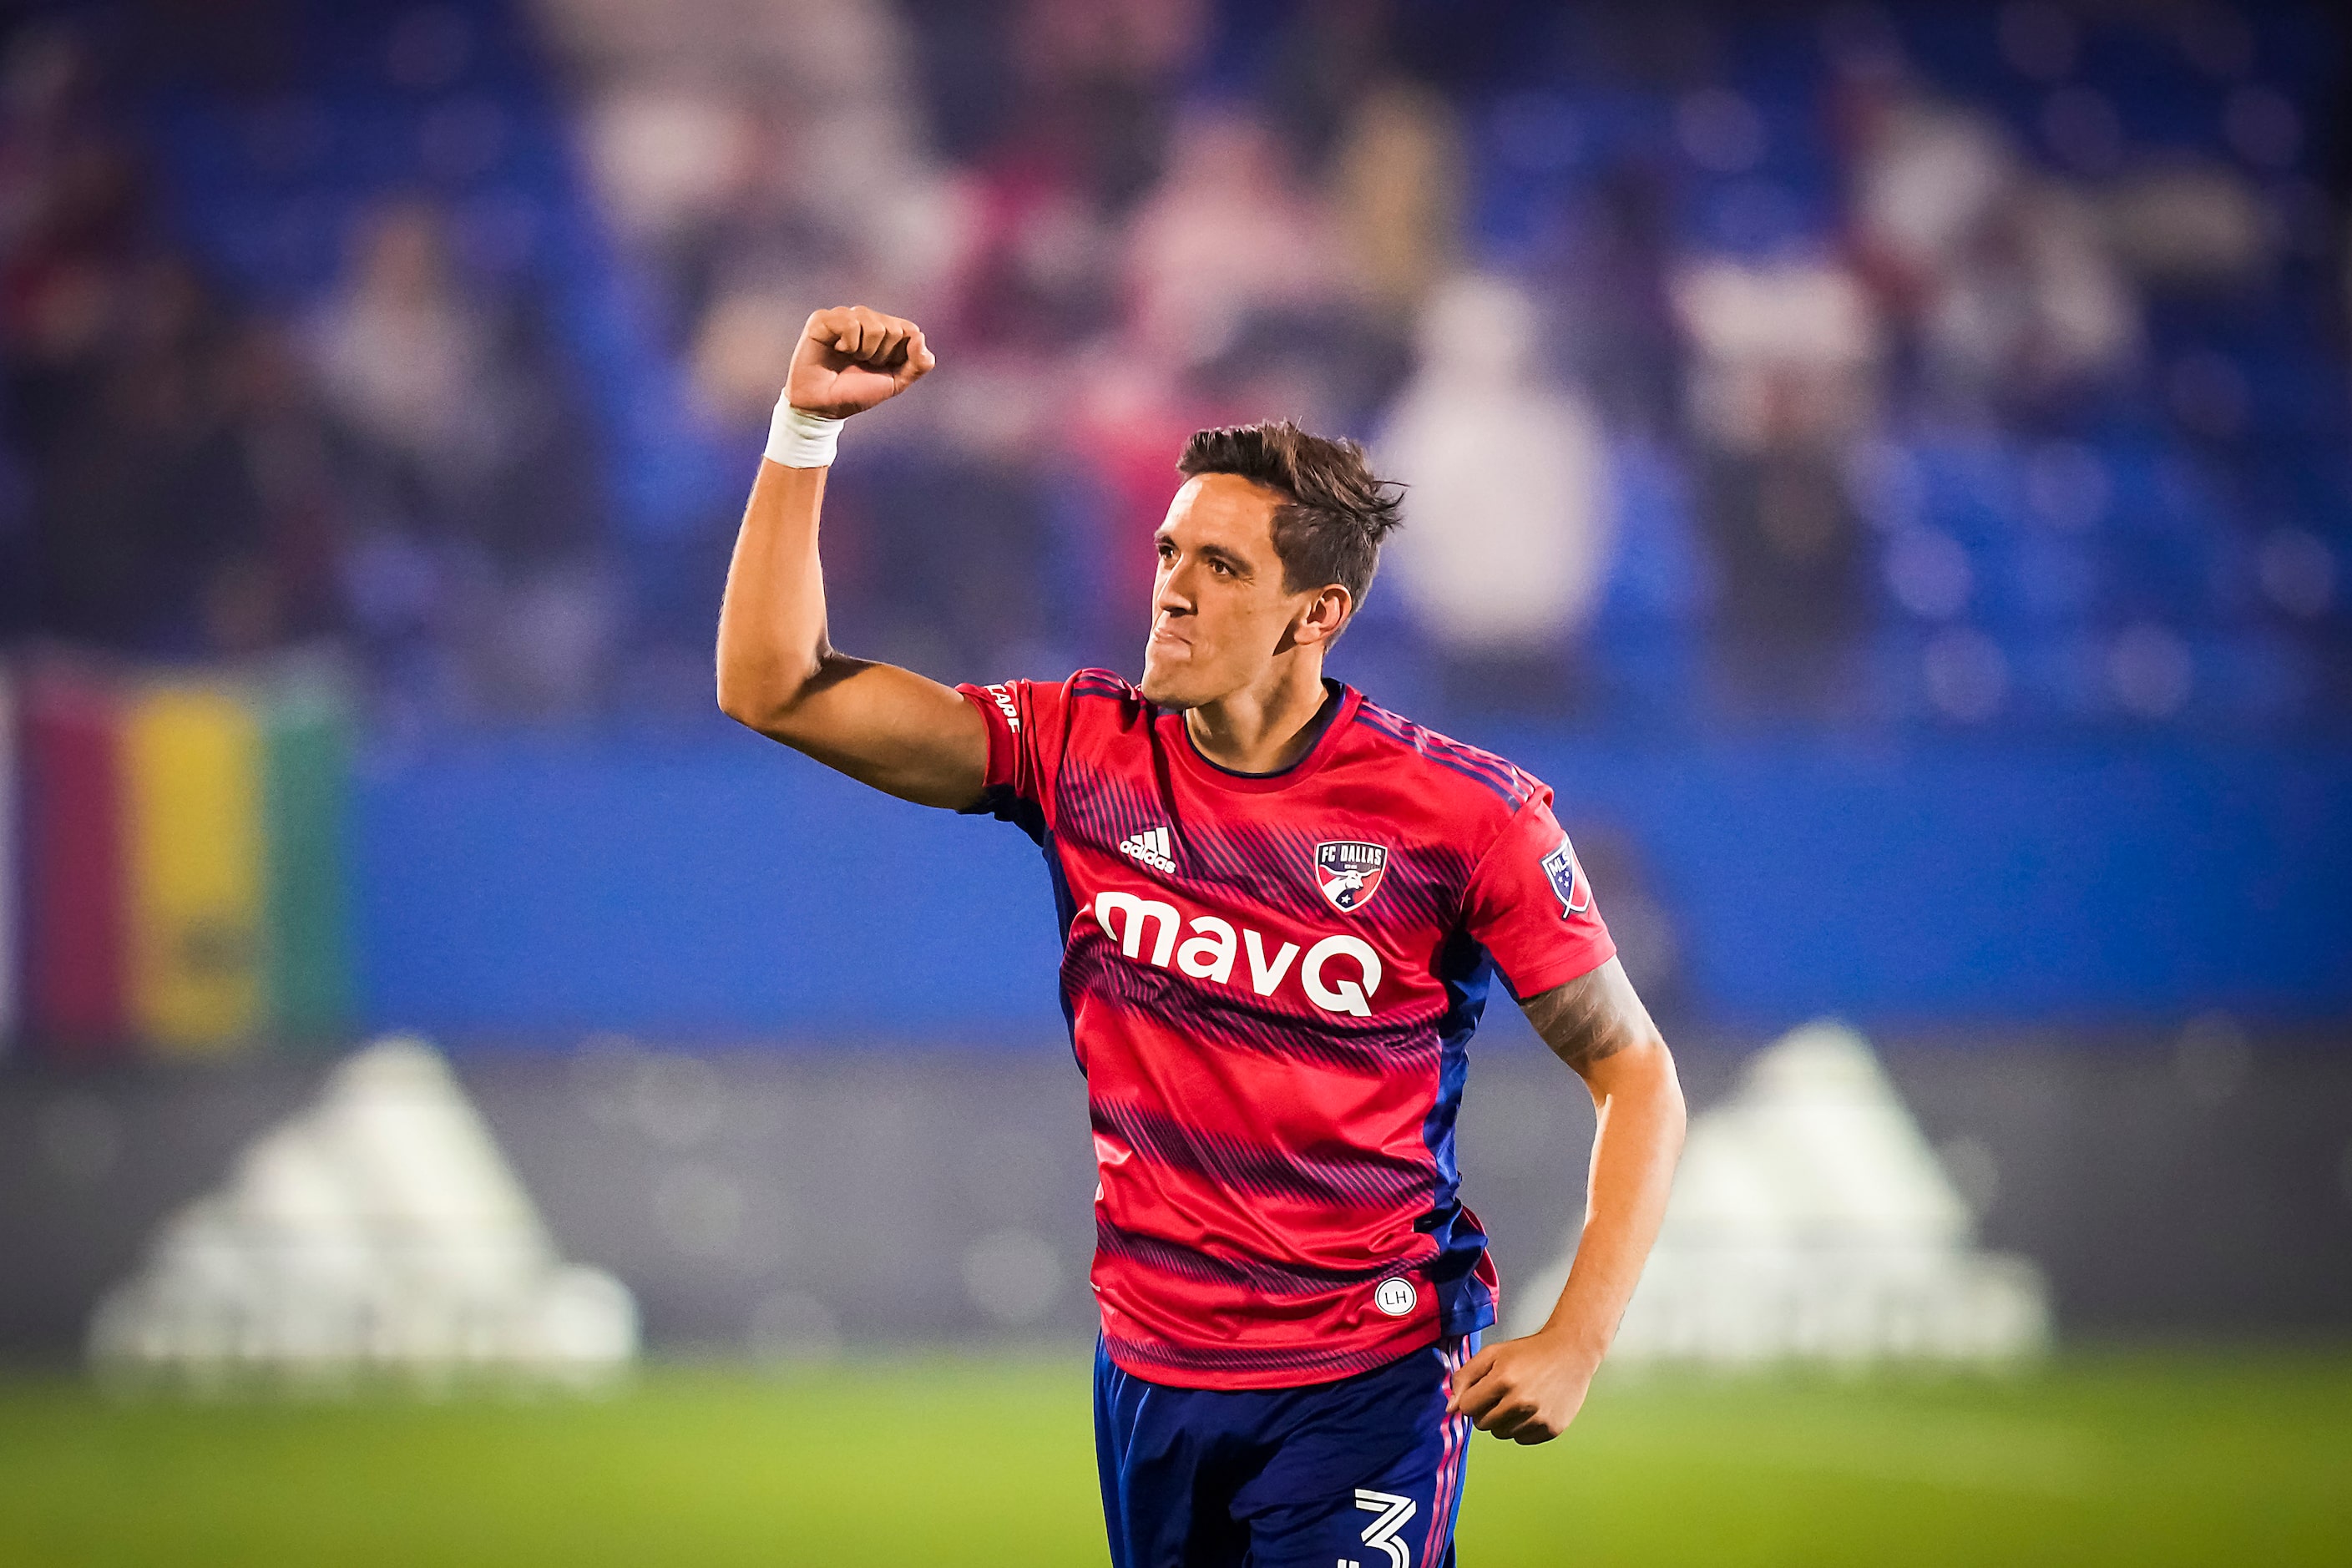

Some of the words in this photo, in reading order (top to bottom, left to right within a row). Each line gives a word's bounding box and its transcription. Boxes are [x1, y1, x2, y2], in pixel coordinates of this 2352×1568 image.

[1120, 840, 1176, 874] adidas
[1321, 846, 1336, 862] FC
[1340, 845, 1382, 866] DALLAS
[1548, 851, 1571, 878] MLS
[1095, 891, 1383, 1017] mavQ
[1384, 1290, 1407, 1305] LH
[1337, 1488, 1417, 1568] 3
